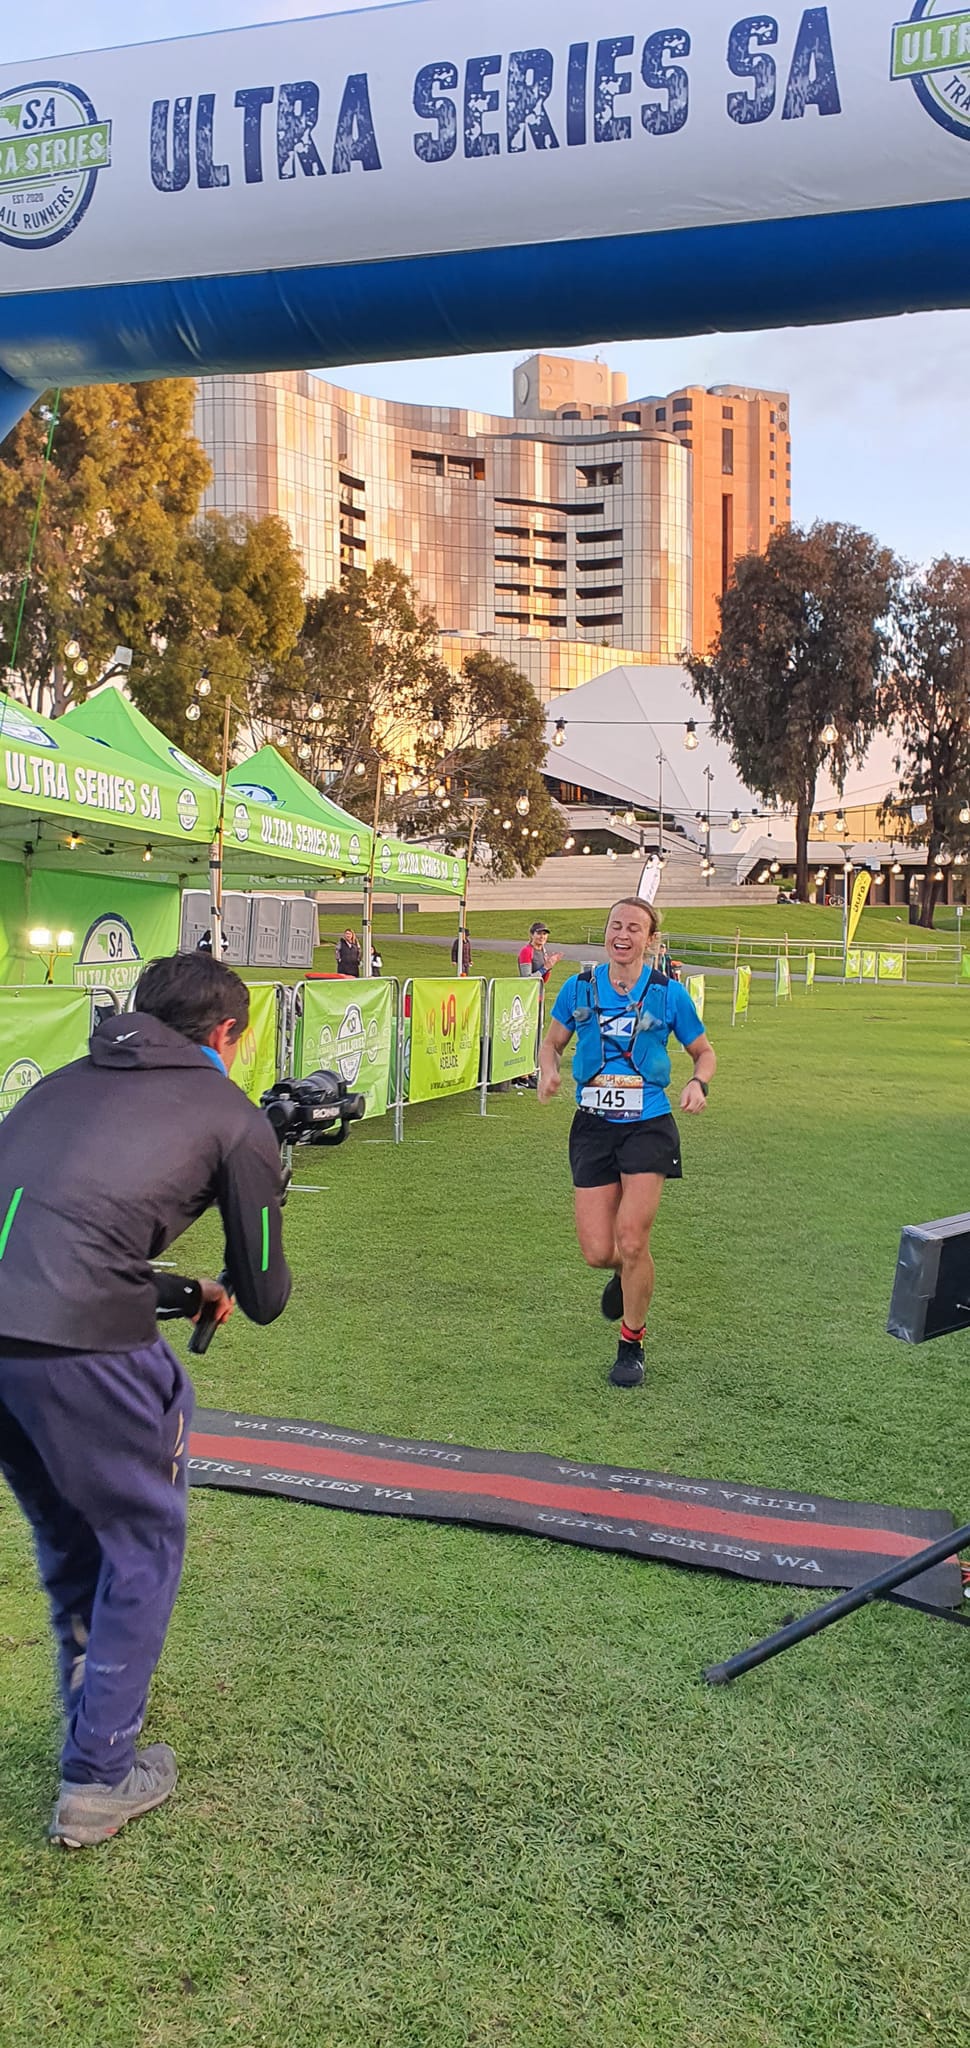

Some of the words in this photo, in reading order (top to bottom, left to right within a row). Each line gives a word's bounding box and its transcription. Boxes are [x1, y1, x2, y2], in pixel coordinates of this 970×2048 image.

[151, 73, 382, 192] ULTRA
[413, 28, 691, 162] SERIES
[727, 6, 841, 125] SA
[22, 97, 56, 130] SA
[25, 132, 105, 171] SERIES
[12, 194, 24, 205] EST
[26, 192, 44, 203] 2020
[23, 185, 74, 229] RUNNERS
[5, 750, 70, 801] ULTRA
[74, 767, 136, 815] SERIES
[139, 783, 162, 820] SA
[261, 814, 294, 849] ULTRA
[295, 823, 327, 857] SERIES
[328, 833, 341, 859] SA
[398, 851, 420, 875] ULTRA
[420, 854, 441, 880] SERIES
[109, 931, 123, 958] SA
[22, 1070, 32, 1086] SA
[595, 1089, 625, 1108] 145
[234, 1420, 267, 1431] WA
[277, 1425, 368, 1446] SERIES
[377, 1442, 463, 1463] ULTRA
[557, 1466, 599, 1480] WA
[608, 1474, 709, 1496] SERIES
[261, 1472, 364, 1494] SERIES
[374, 1487, 415, 1502] WA
[720, 1489, 817, 1514] ULTRA
[537, 1513, 639, 1538] ULTRA
[648, 1532, 761, 1562] SERIES
[772, 1553, 824, 1573] WA
